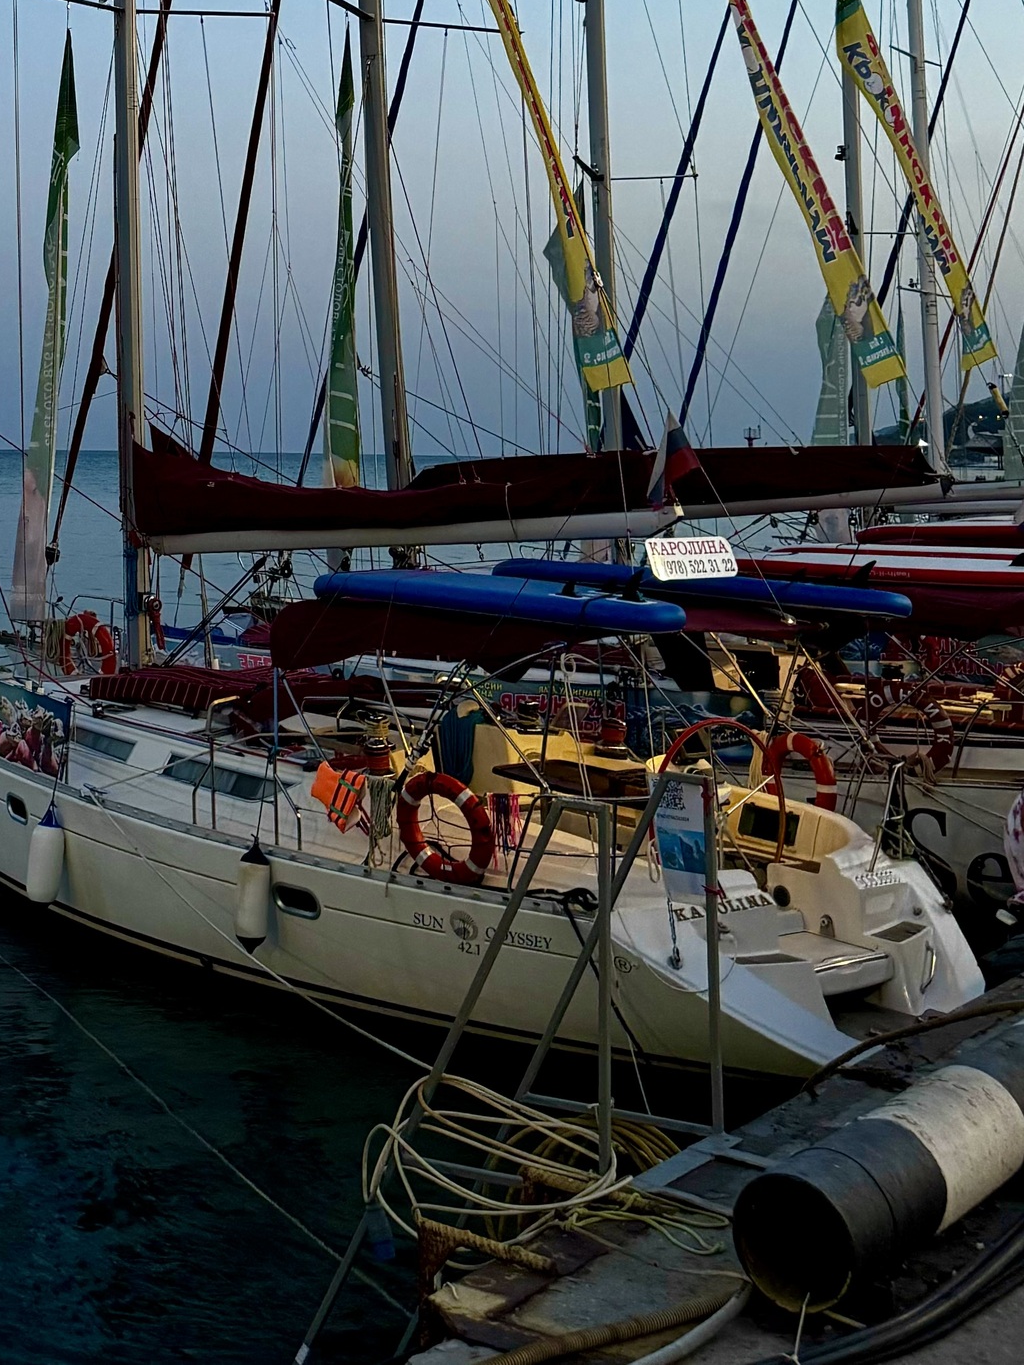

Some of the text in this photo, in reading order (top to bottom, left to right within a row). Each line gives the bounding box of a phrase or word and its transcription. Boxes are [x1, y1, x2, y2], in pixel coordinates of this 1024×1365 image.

[648, 539, 729, 556] КАРОЛИНА
[689, 559, 707, 574] 522
[708, 559, 721, 573] 31
[722, 558, 736, 572] 22
[673, 894, 773, 921] KAOLINA
[413, 912, 444, 929] SUN
[458, 941, 481, 956] 42.1
